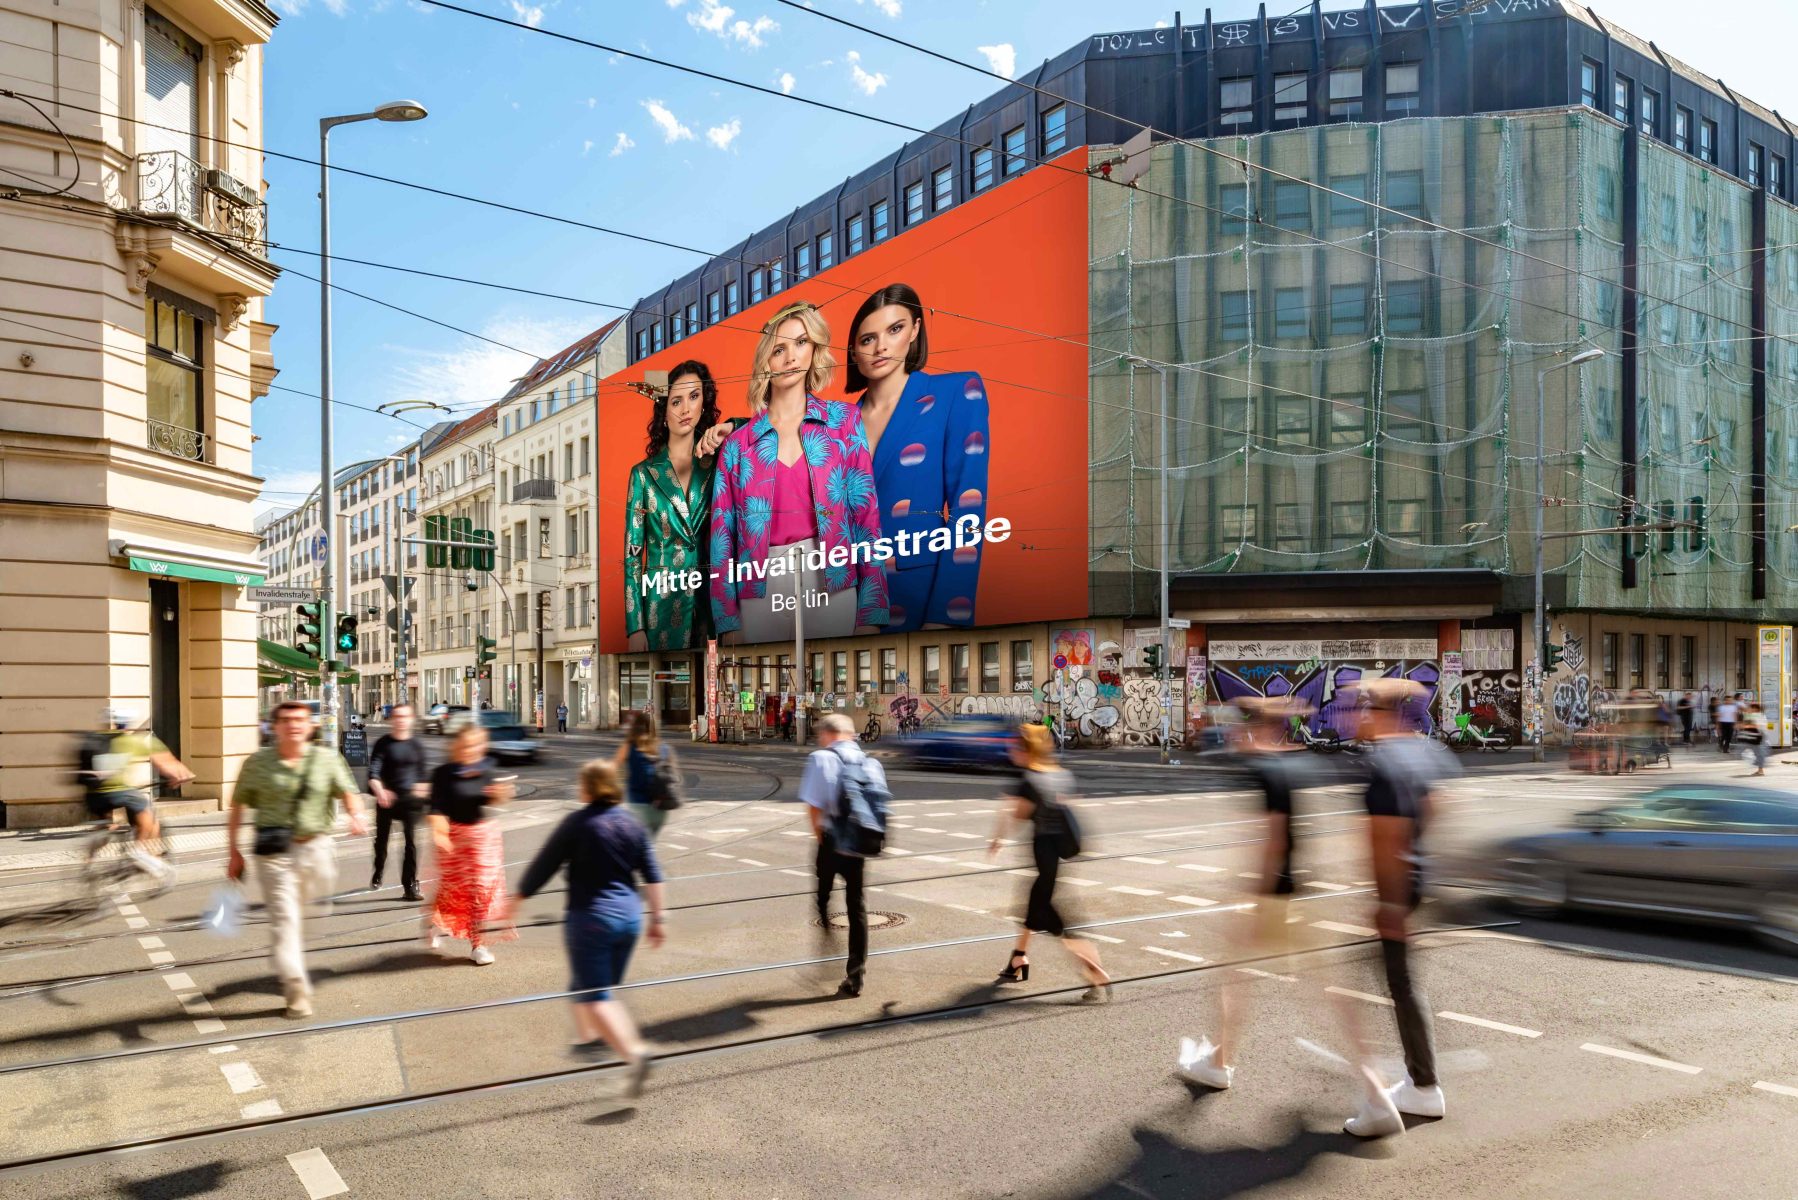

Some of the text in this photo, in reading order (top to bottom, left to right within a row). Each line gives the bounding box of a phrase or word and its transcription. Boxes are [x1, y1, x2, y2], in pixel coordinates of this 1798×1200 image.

[255, 589, 311, 600] Invalidenstraße
[641, 568, 703, 597] Mitte
[771, 588, 829, 612] Belin
[1563, 645, 1582, 666] OBEY
[1238, 656, 1319, 680] STREET ART
